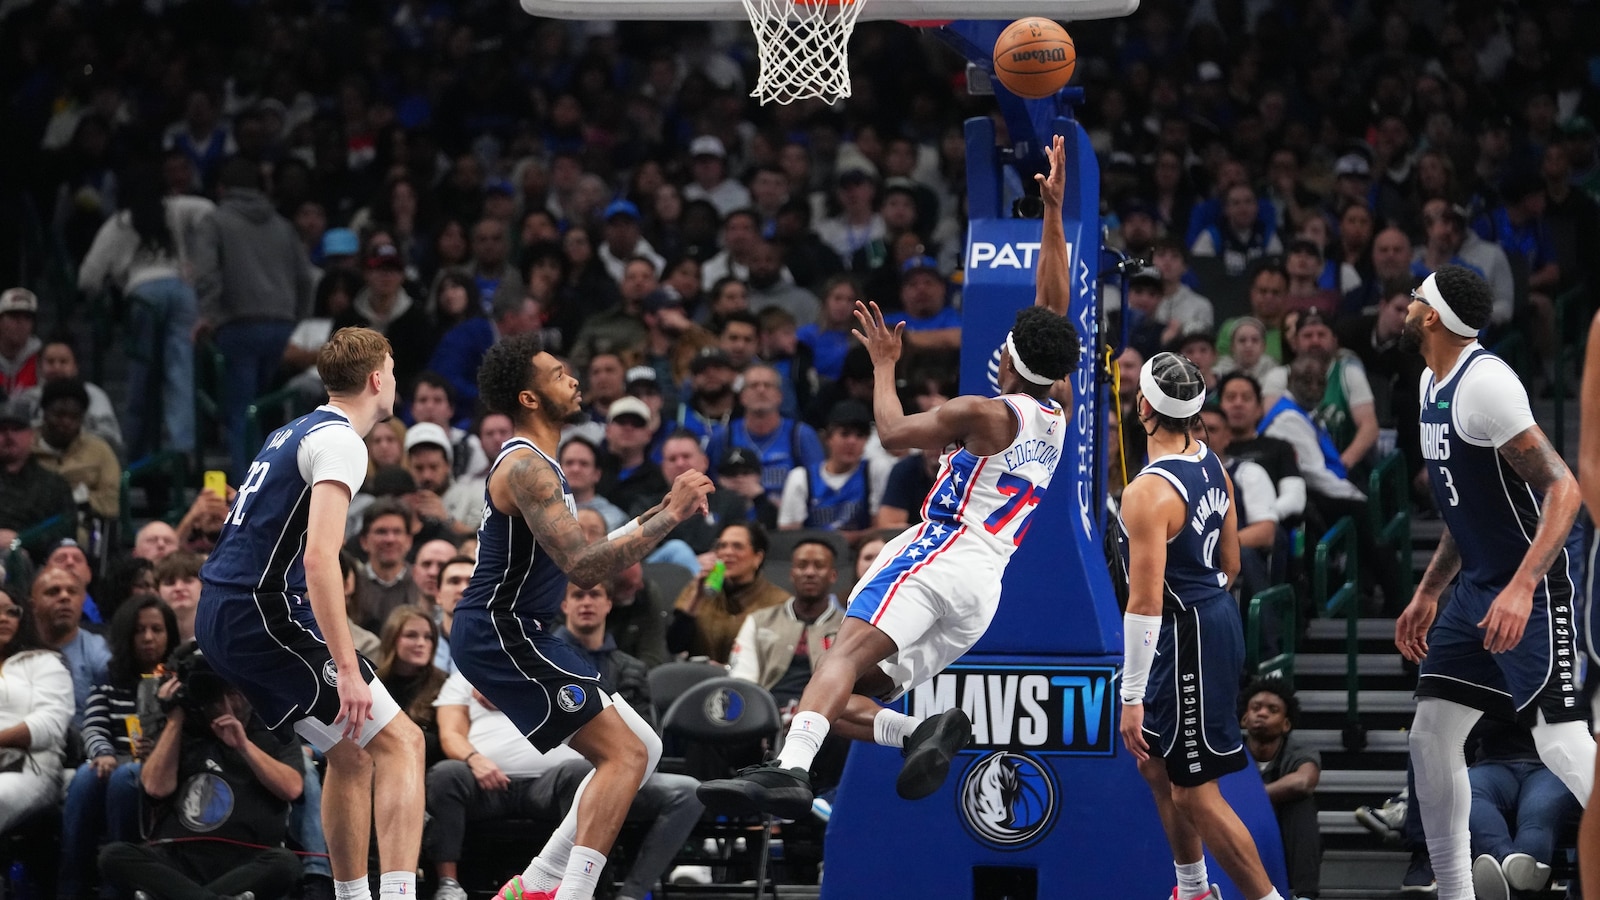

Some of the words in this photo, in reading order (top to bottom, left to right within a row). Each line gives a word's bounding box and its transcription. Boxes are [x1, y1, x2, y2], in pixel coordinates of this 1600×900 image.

[1012, 47, 1066, 64] Wilson
[970, 242, 1072, 269] PAT
[1439, 466, 1459, 507] 3
[913, 673, 1049, 746] MAVS
